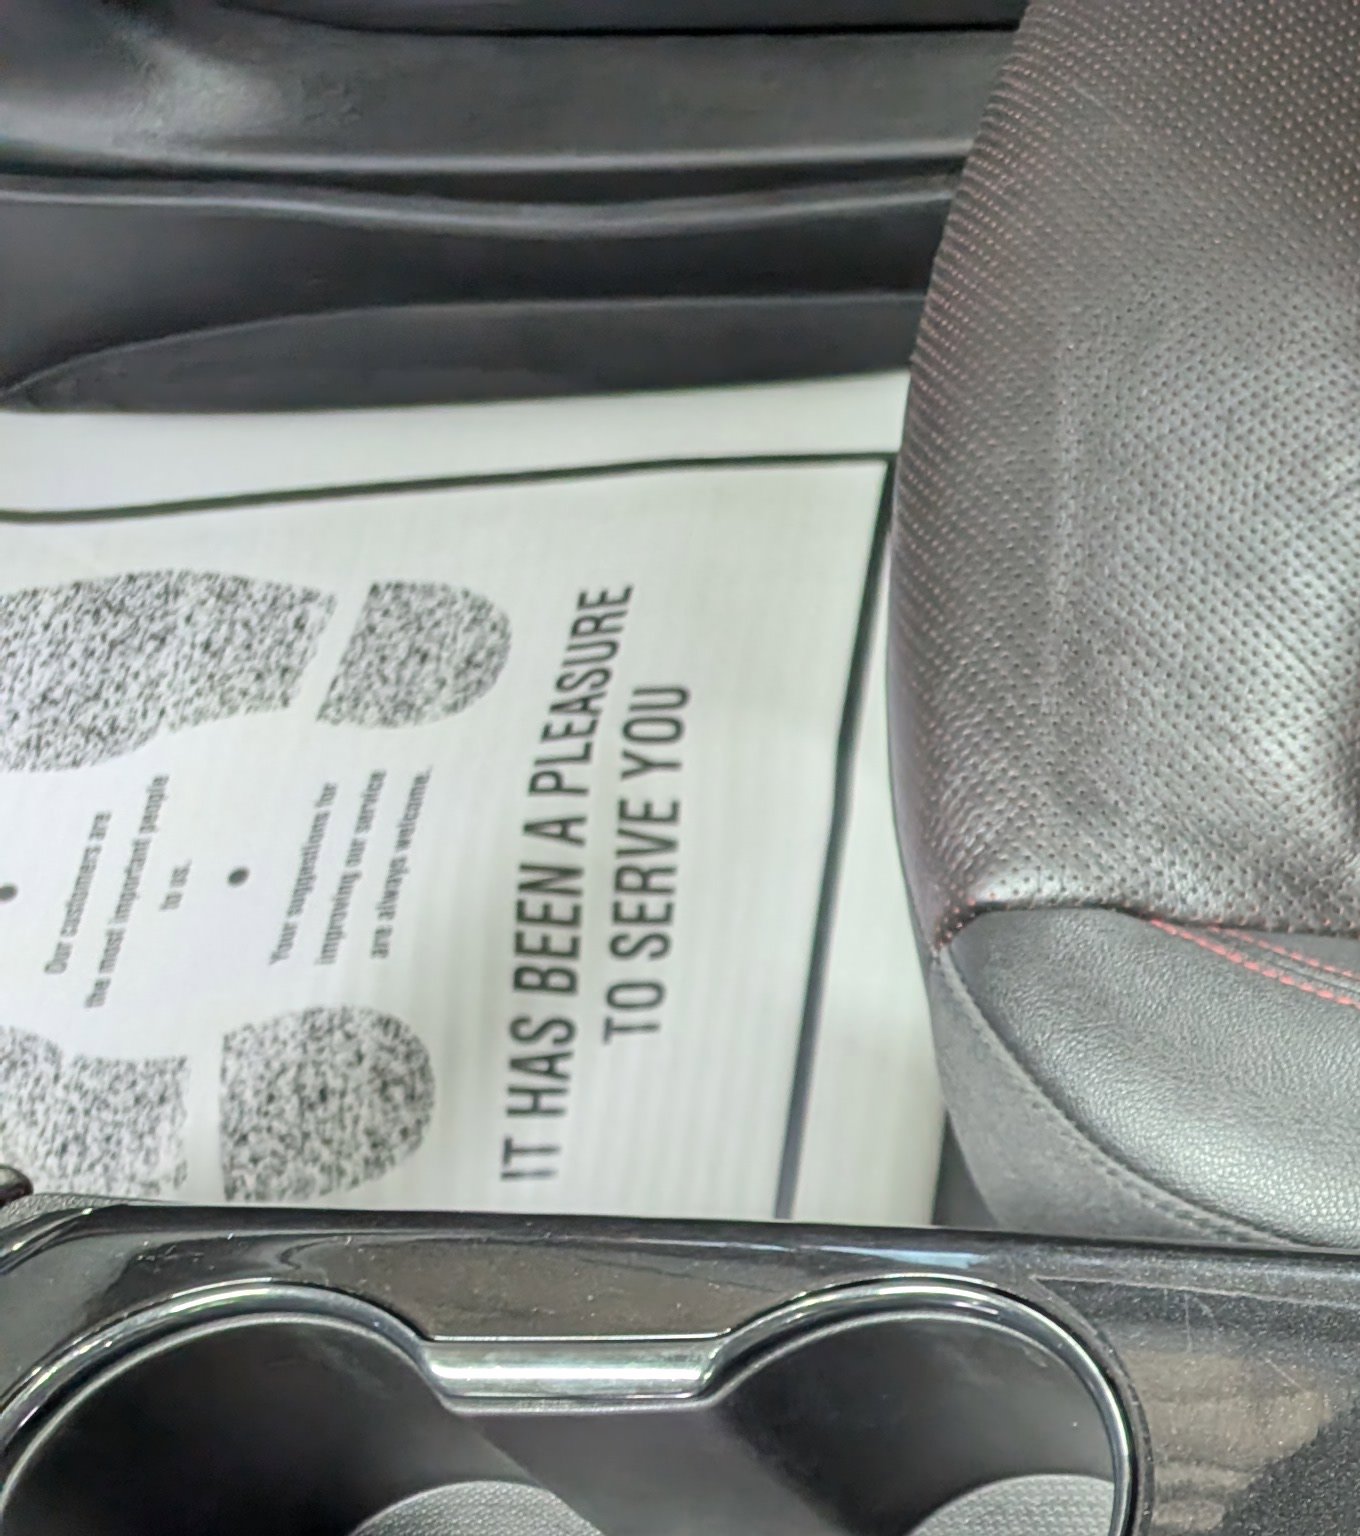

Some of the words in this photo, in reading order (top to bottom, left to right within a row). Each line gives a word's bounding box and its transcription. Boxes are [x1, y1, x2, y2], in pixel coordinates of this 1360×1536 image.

[527, 585, 634, 796] PLEASURE
[618, 687, 690, 780] YOU
[138, 775, 169, 834] people
[354, 770, 386, 834] service
[393, 765, 432, 852] welcome.
[522, 816, 587, 847] A
[107, 838, 150, 924] important
[268, 923, 298, 965] Your
[286, 811, 331, 917] suggestions
[315, 783, 338, 808] for
[344, 839, 366, 867] our
[609, 799, 681, 961] SERVE
[43, 942, 73, 974] Our
[60, 845, 102, 938] customers
[88, 813, 112, 842] are
[158, 892, 183, 911] to
[313, 872, 362, 965] improving
[375, 856, 410, 920] always
[98, 928, 125, 974] most
[369, 927, 392, 958] are
[512, 864, 584, 996] BEEN
[83, 978, 111, 1008] the
[602, 981, 665, 1044] TO
[506, 1017, 576, 1117] HAS
[500, 1138, 560, 1181] IT
